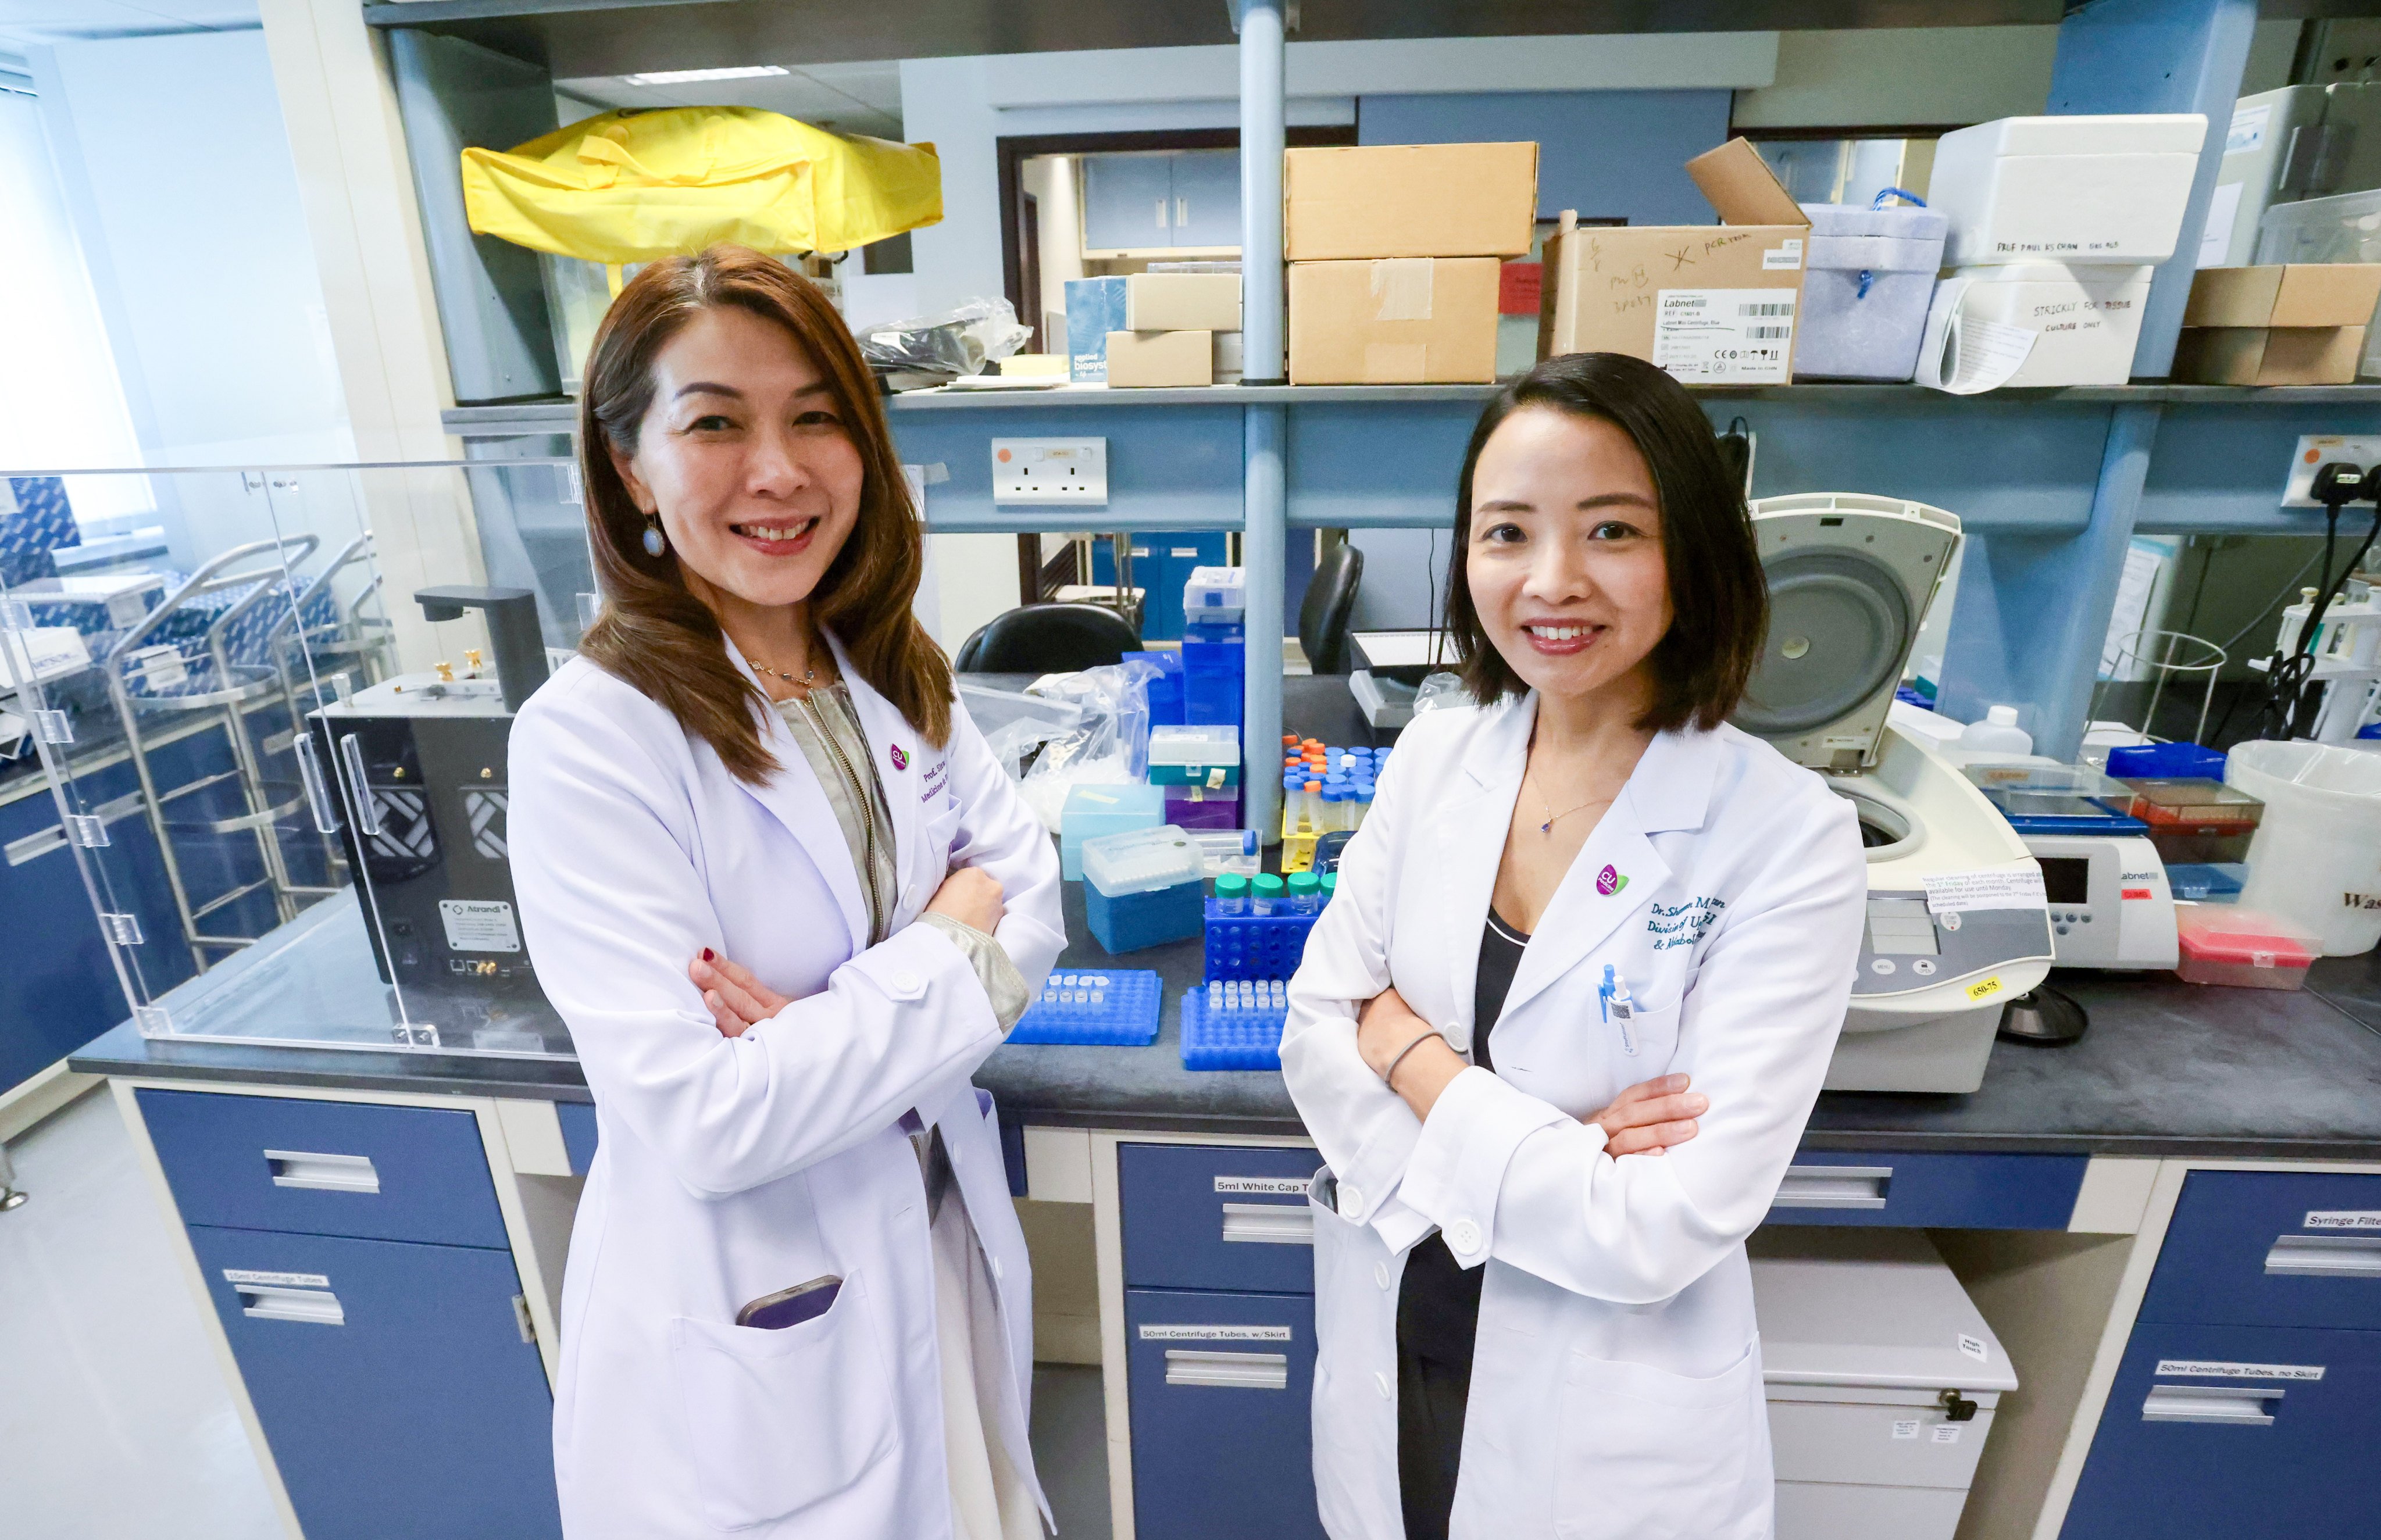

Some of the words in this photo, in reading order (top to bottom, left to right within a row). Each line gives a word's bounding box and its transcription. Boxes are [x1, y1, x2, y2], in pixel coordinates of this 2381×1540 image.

[1664, 299, 1695, 308] Labnet
[2034, 301, 2078, 317] STRICKLY
[2084, 302, 2098, 310] FOR
[1074, 353, 1098, 362] applied
[893, 750, 902, 760] CU
[921, 782, 943, 803] Medicine
[1601, 871, 1616, 884] CU
[1598, 877, 1614, 891] Medicine
[1651, 903, 1665, 916] Dr.
[1654, 939, 1665, 951] &
[1973, 981, 1998, 997] 650-75
[1218, 1182, 1239, 1190] 5ml
[1243, 1182, 1275, 1191] White
[1277, 1183, 1299, 1192] Cap
[2309, 1216, 2354, 1226] Syringe
[2357, 1217, 2381, 1225] Filte
[1170, 1331, 1217, 1339] Centrifuge
[1962, 1343, 1981, 1355] Touch
[1965, 1339, 1980, 1348] High
[2190, 1365, 2240, 1375] Centrifuge
[2294, 1370, 2319, 1379] Skirt
